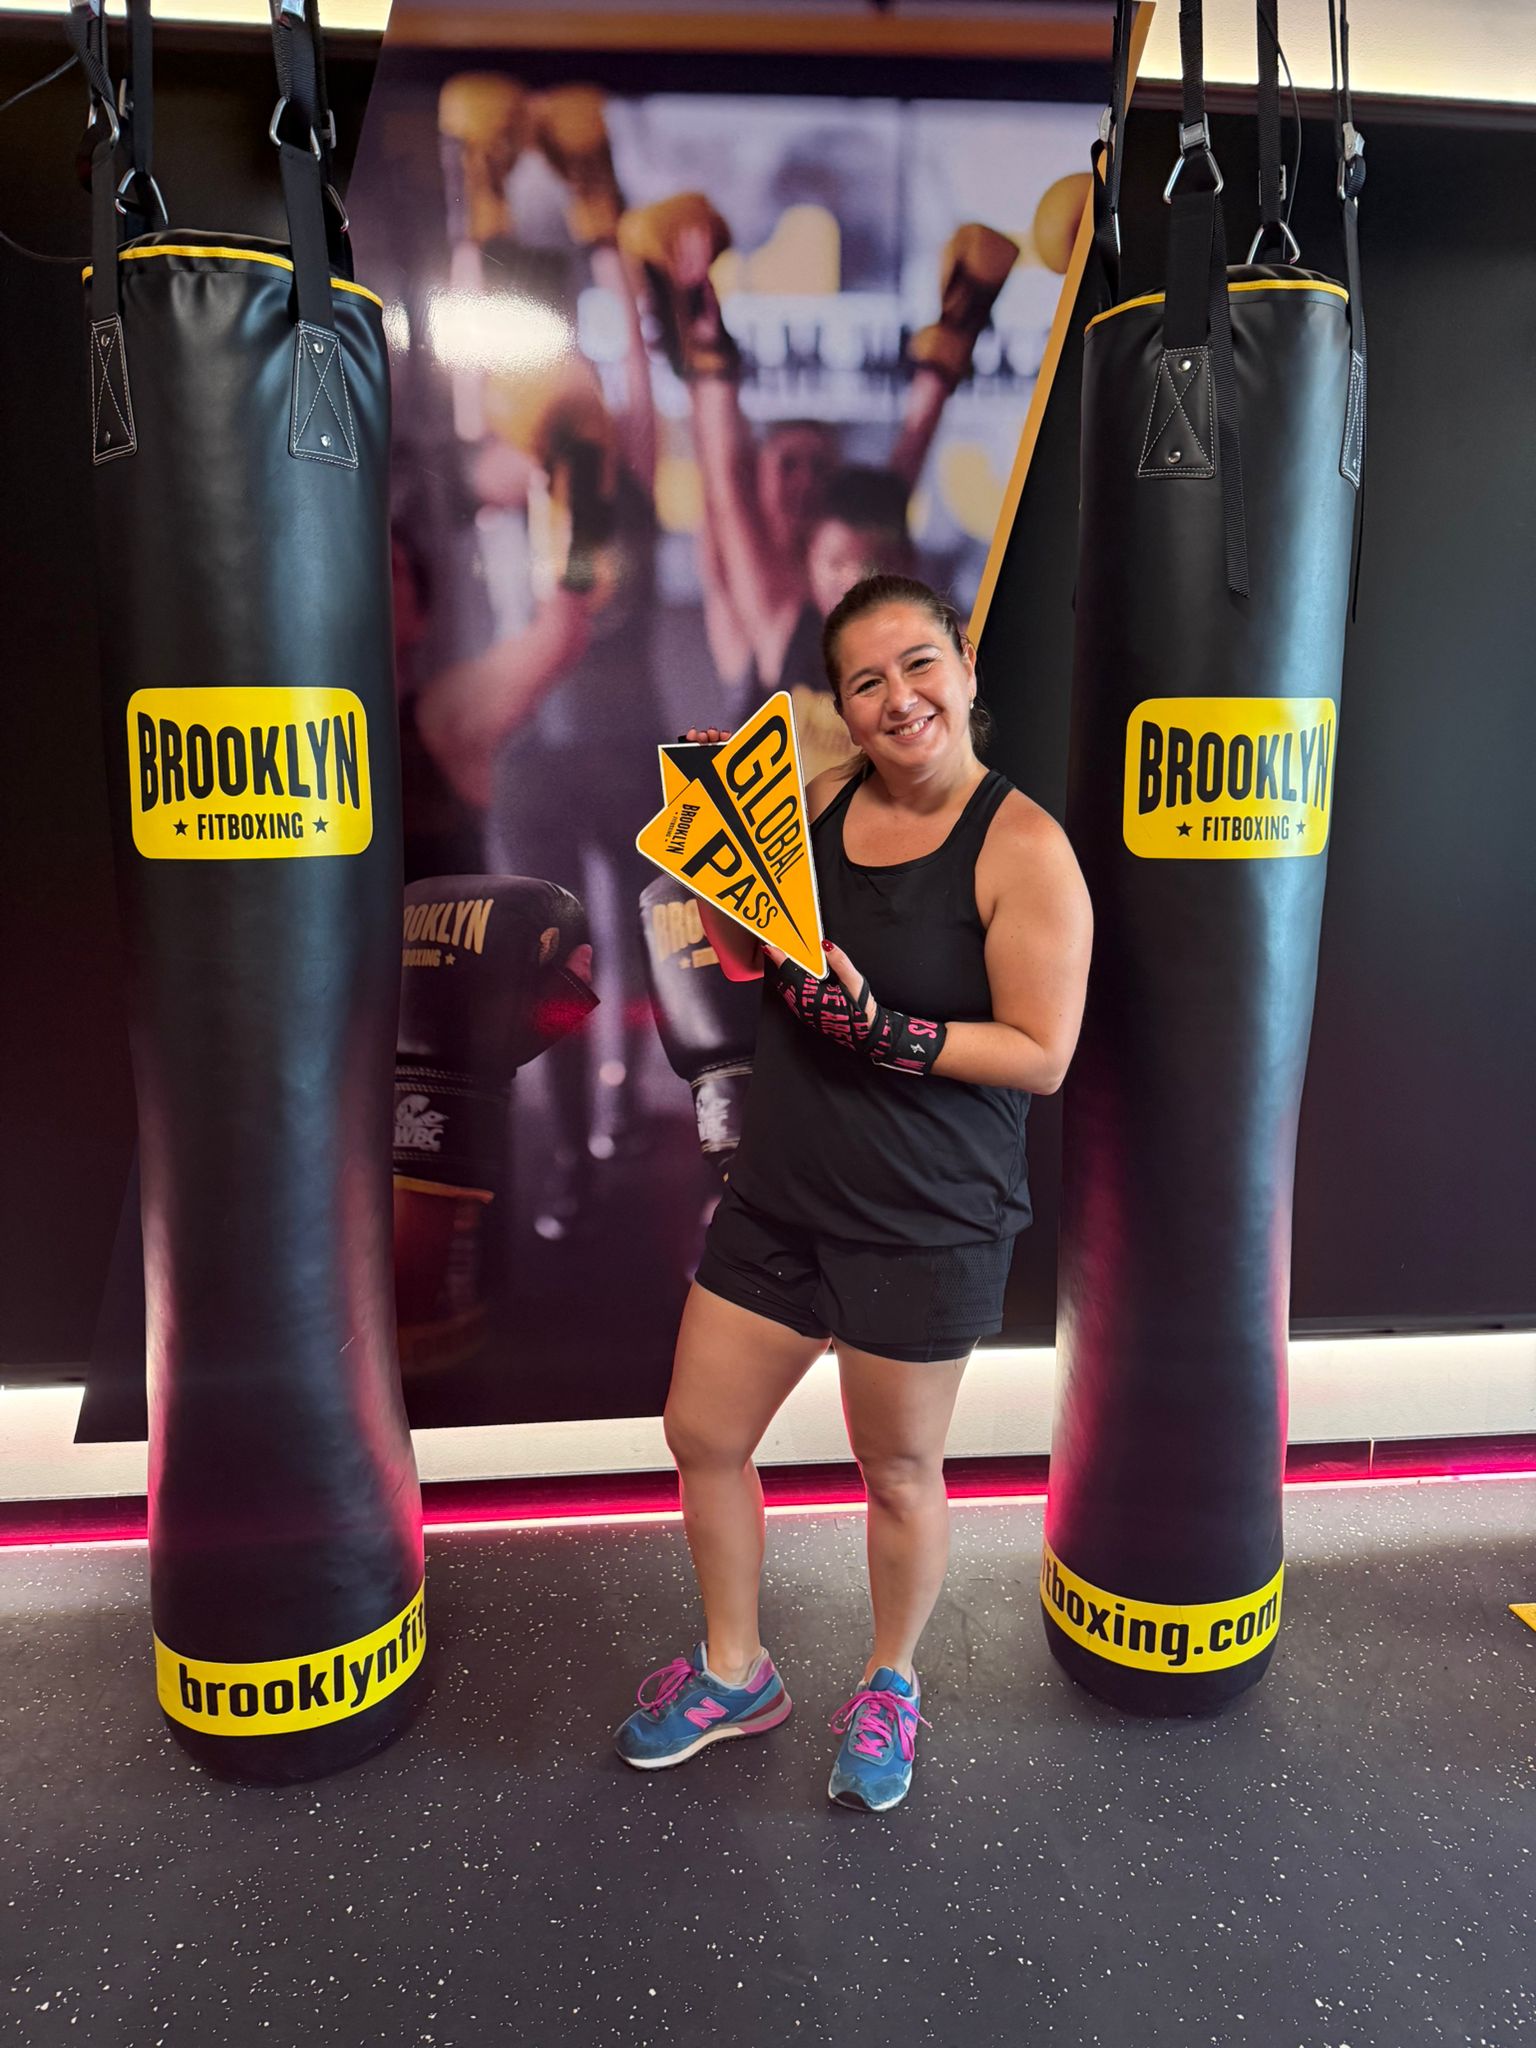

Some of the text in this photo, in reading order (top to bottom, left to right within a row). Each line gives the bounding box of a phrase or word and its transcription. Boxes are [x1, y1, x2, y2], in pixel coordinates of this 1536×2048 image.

[137, 711, 361, 813] BROOKLYN
[726, 715, 805, 884] GLOBAL
[1139, 719, 1332, 815] BROOKLYN
[197, 812, 304, 840] FITBOXING
[665, 804, 701, 855] BROOKLYN
[1203, 815, 1289, 841] FITBOXING
[680, 829, 778, 928] PASS
[178, 1602, 424, 1717] brooklynfit
